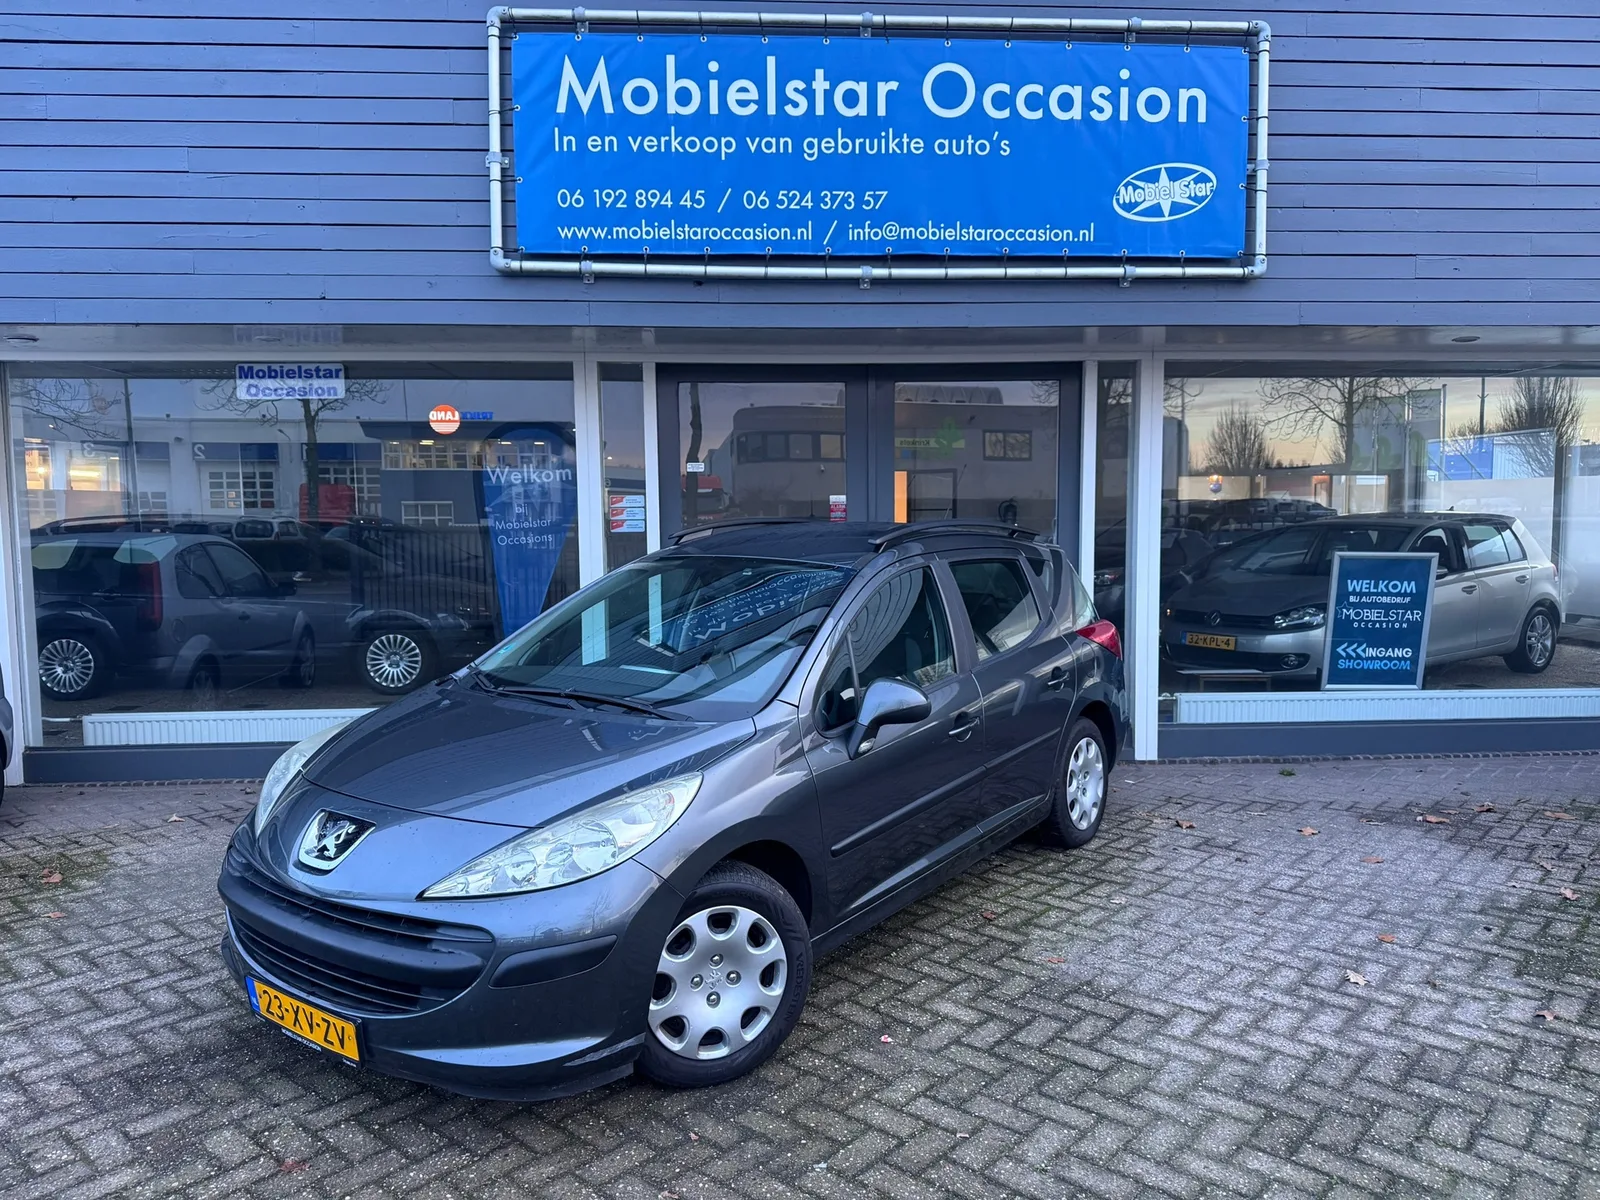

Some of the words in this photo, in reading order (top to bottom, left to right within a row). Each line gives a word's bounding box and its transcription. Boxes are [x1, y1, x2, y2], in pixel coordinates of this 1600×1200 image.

[555, 54, 899, 117] Mobielstar
[922, 62, 1207, 123] Occasion
[554, 127, 576, 152] In
[587, 133, 618, 152] en
[627, 126, 737, 161] verkoop
[745, 134, 793, 154] van
[803, 127, 925, 162] gebruikte
[934, 131, 1011, 156] auto's
[557, 188, 585, 208] 06
[592, 188, 627, 208] 192
[635, 189, 673, 209] 894
[679, 190, 705, 209] 45
[743, 190, 770, 209] 06
[776, 190, 814, 210] 524
[820, 190, 855, 210] 373
[862, 190, 888, 210] 57
[1119, 181, 1175, 204] Mobiel
[1180, 180, 1213, 199] Star
[557, 219, 813, 241] www.mobielstaroccasion.nl
[848, 220, 1095, 243] info@mobielstaroccasion.nl
[238, 365, 343, 380] Mobielstar
[247, 383, 338, 397] Occasion
[486, 463, 572, 485] Welkom
[515, 503, 528, 516] bij
[496, 517, 552, 530] Mobielstar
[497, 534, 553, 545] Occasions
[1347, 579, 1416, 593] WELKOM
[1349, 595, 1360, 603] BIJ
[1361, 596, 1411, 604] AUTOBEDRIJF
[1342, 608, 1422, 622] MOBIELSTAR
[1188, 633, 1230, 648] 32-KPL-4
[1365, 647, 1413, 658] INGANG
[1337, 659, 1411, 670] SHOWROOM
[262, 989, 345, 1050] 23-XV-ZV
